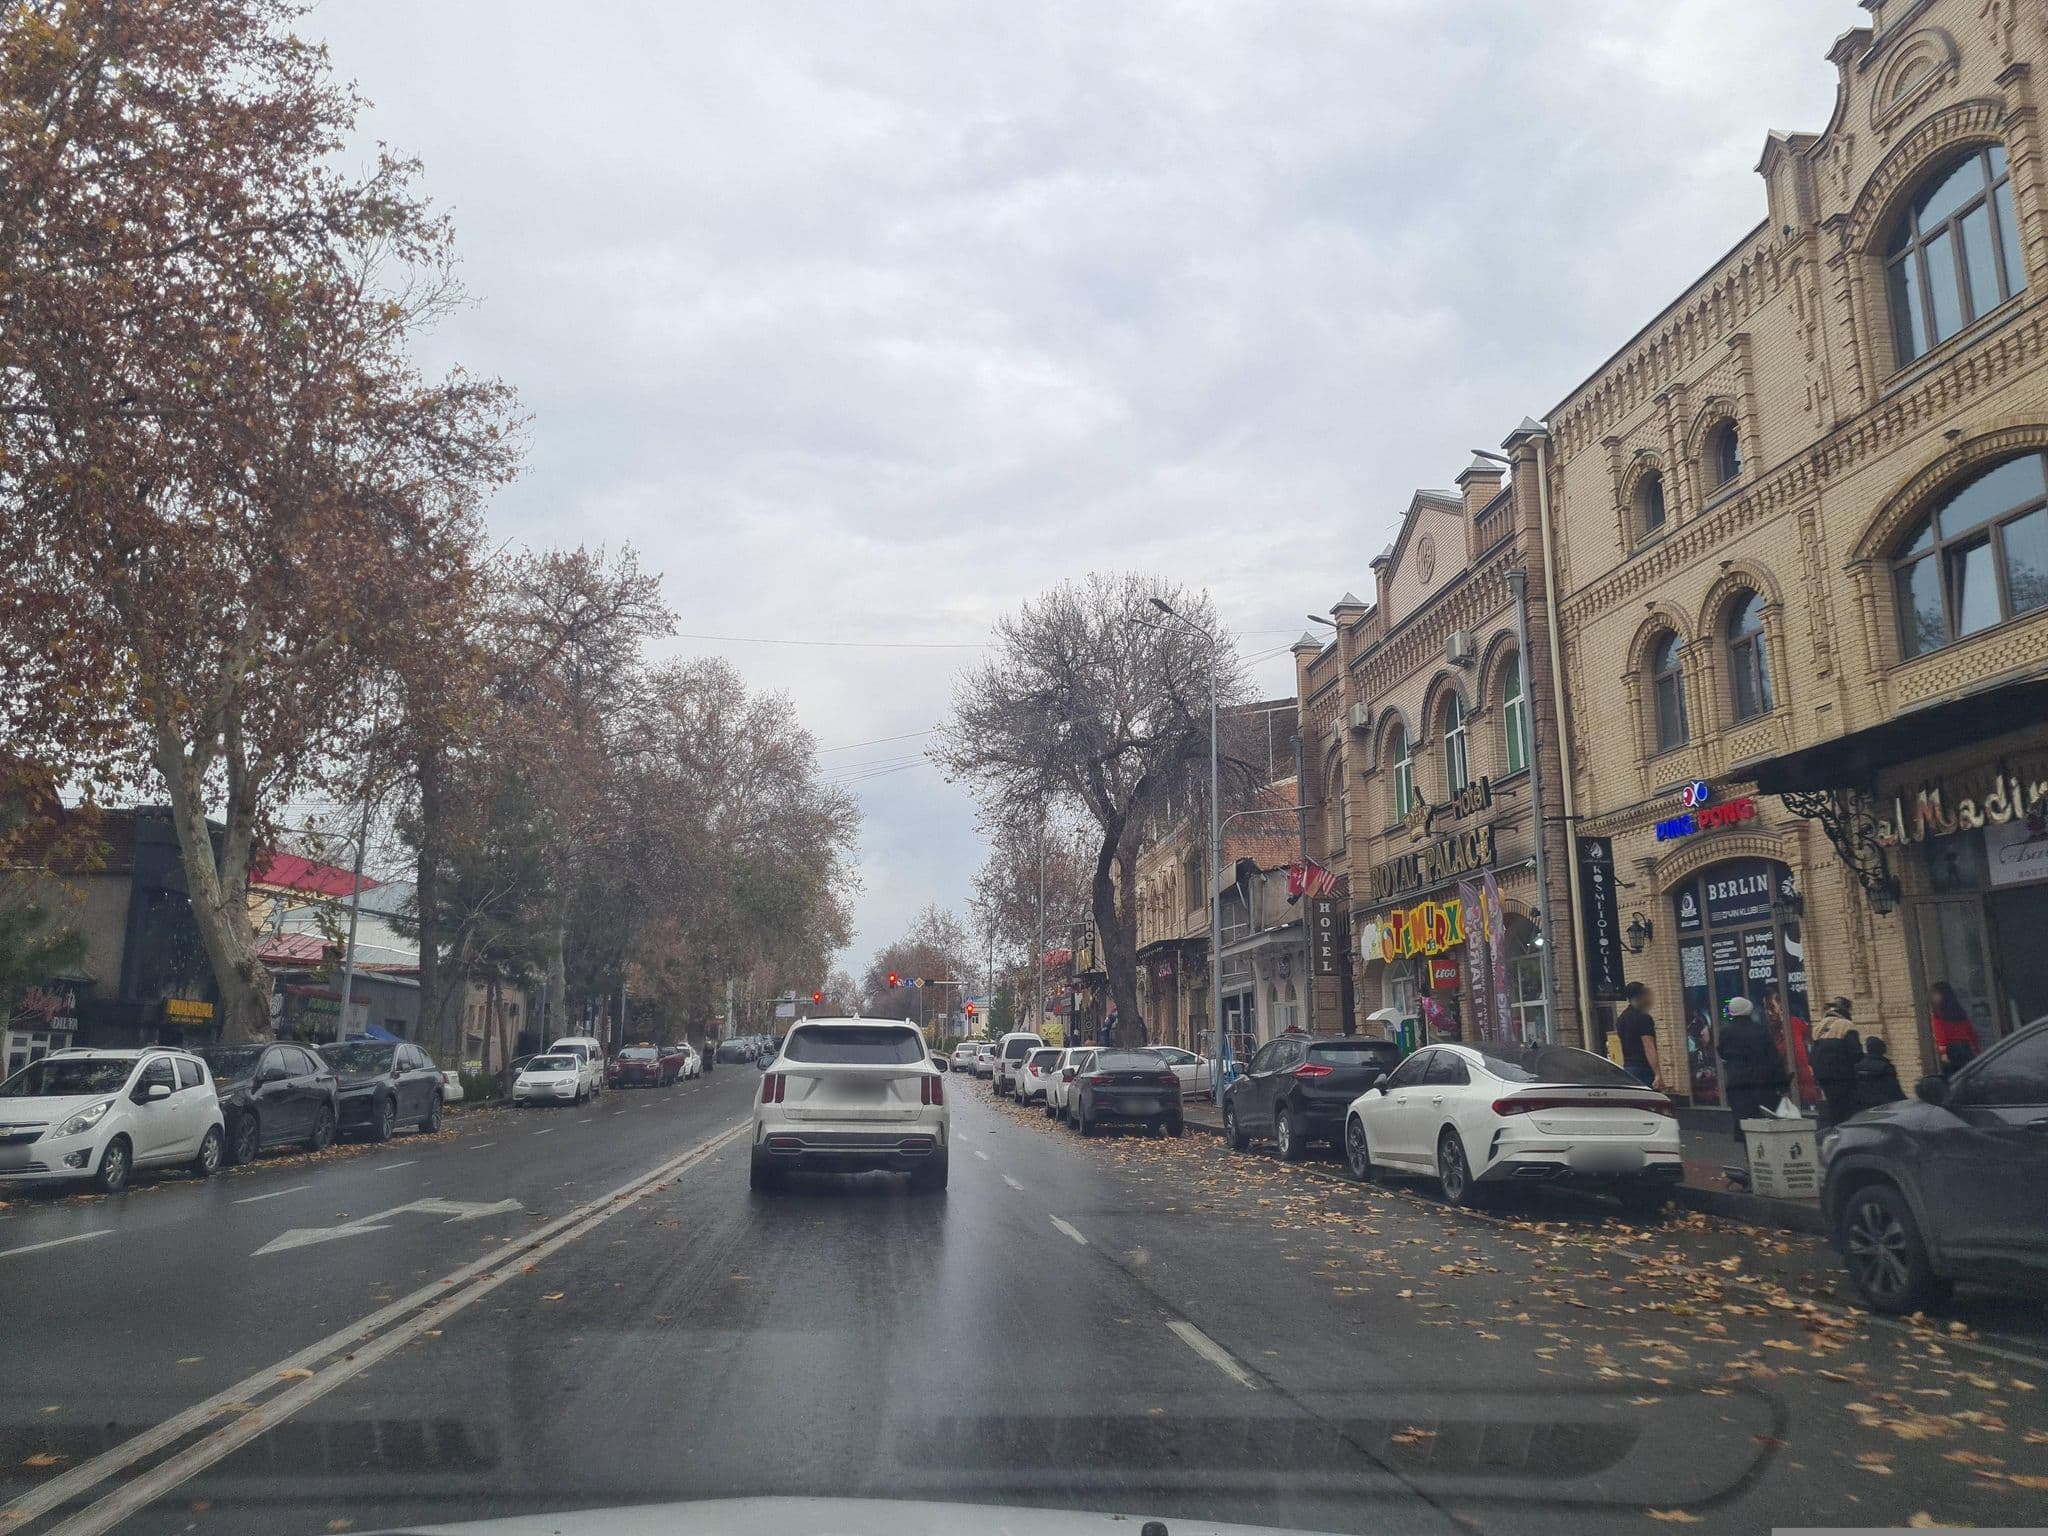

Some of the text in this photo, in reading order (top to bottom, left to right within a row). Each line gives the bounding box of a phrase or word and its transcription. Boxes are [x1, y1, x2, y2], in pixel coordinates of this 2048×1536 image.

[1451, 775, 1492, 820] Hotel
[1655, 796, 1755, 842] PING PONG
[1370, 825, 1496, 898] ROYAL PALACE
[1708, 874, 1768, 900] BERLIN
[1320, 903, 1332, 971] HOTEL
[1436, 968, 1456, 979] LEGO
